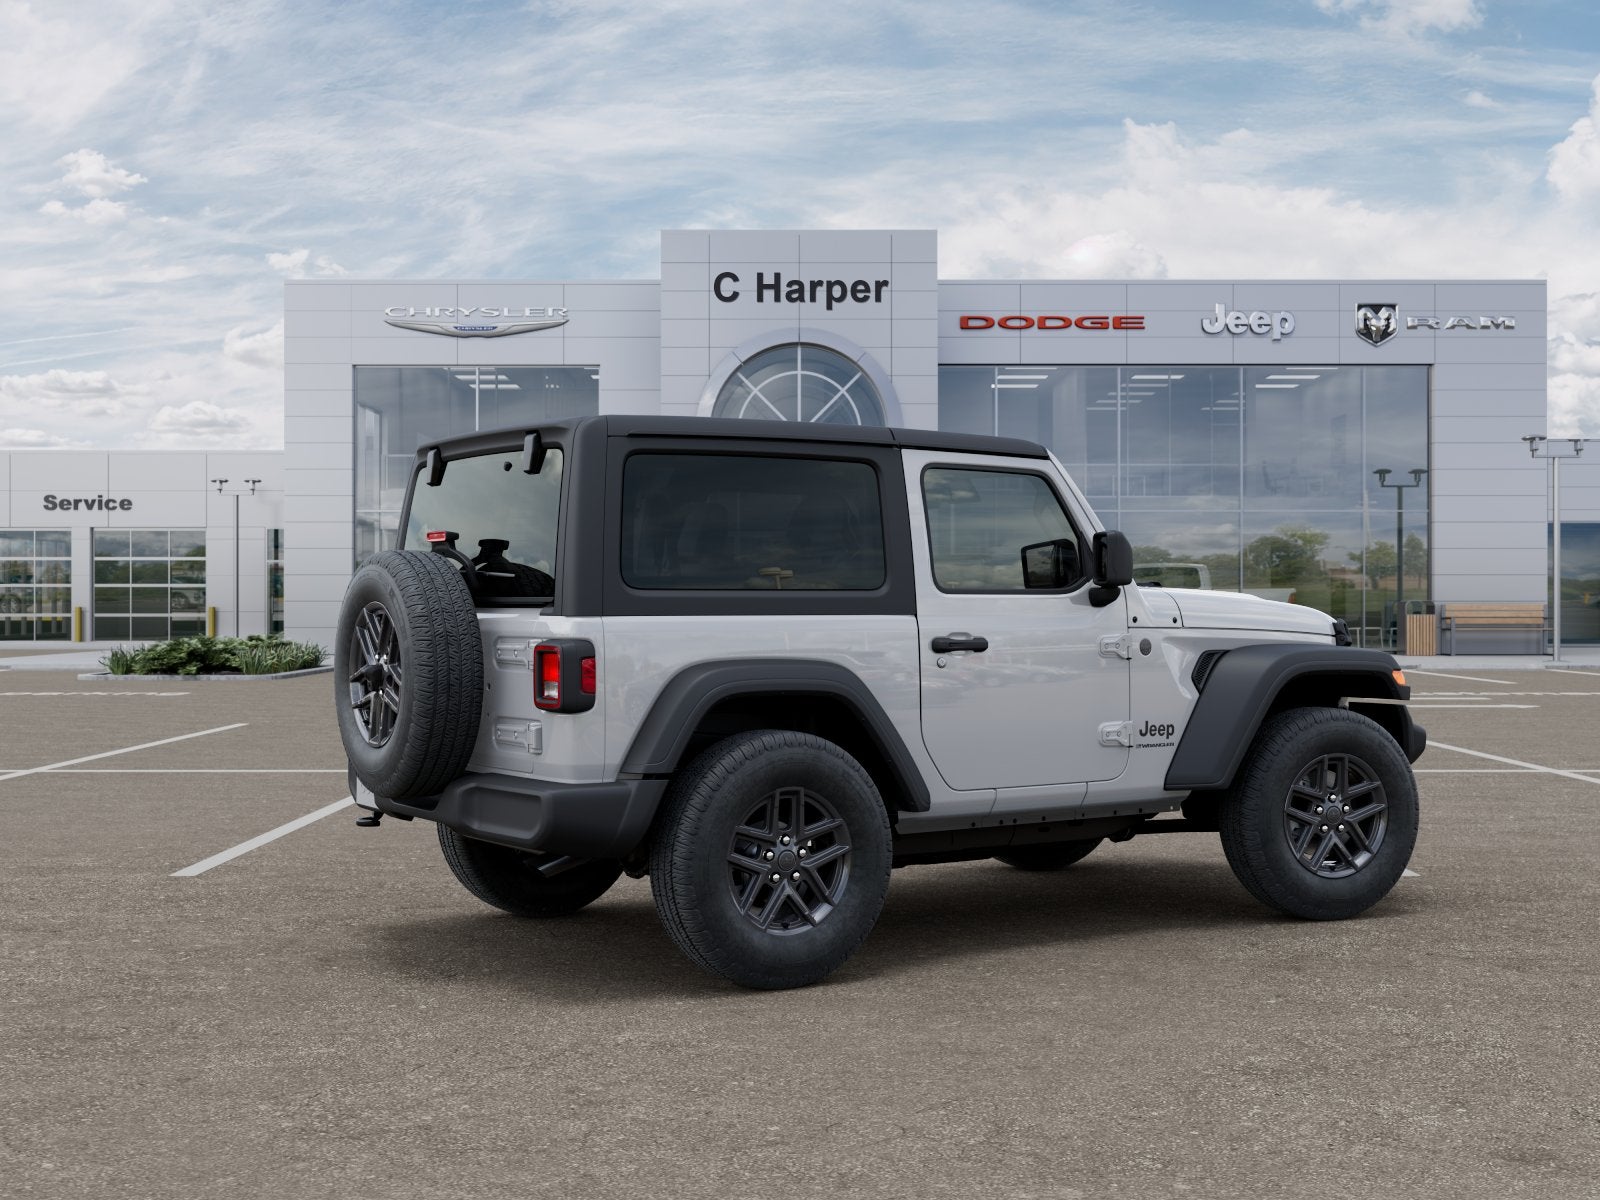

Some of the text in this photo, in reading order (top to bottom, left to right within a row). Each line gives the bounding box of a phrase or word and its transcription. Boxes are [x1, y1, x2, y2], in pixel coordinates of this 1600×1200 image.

[713, 272, 890, 311] C Harper
[385, 306, 568, 317] CHRYSLER
[960, 315, 1146, 330] DODGE
[1201, 303, 1295, 342] Jeep
[1407, 315, 1516, 330] RAM
[43, 494, 133, 511] Service
[1139, 720, 1175, 739] Jeep
